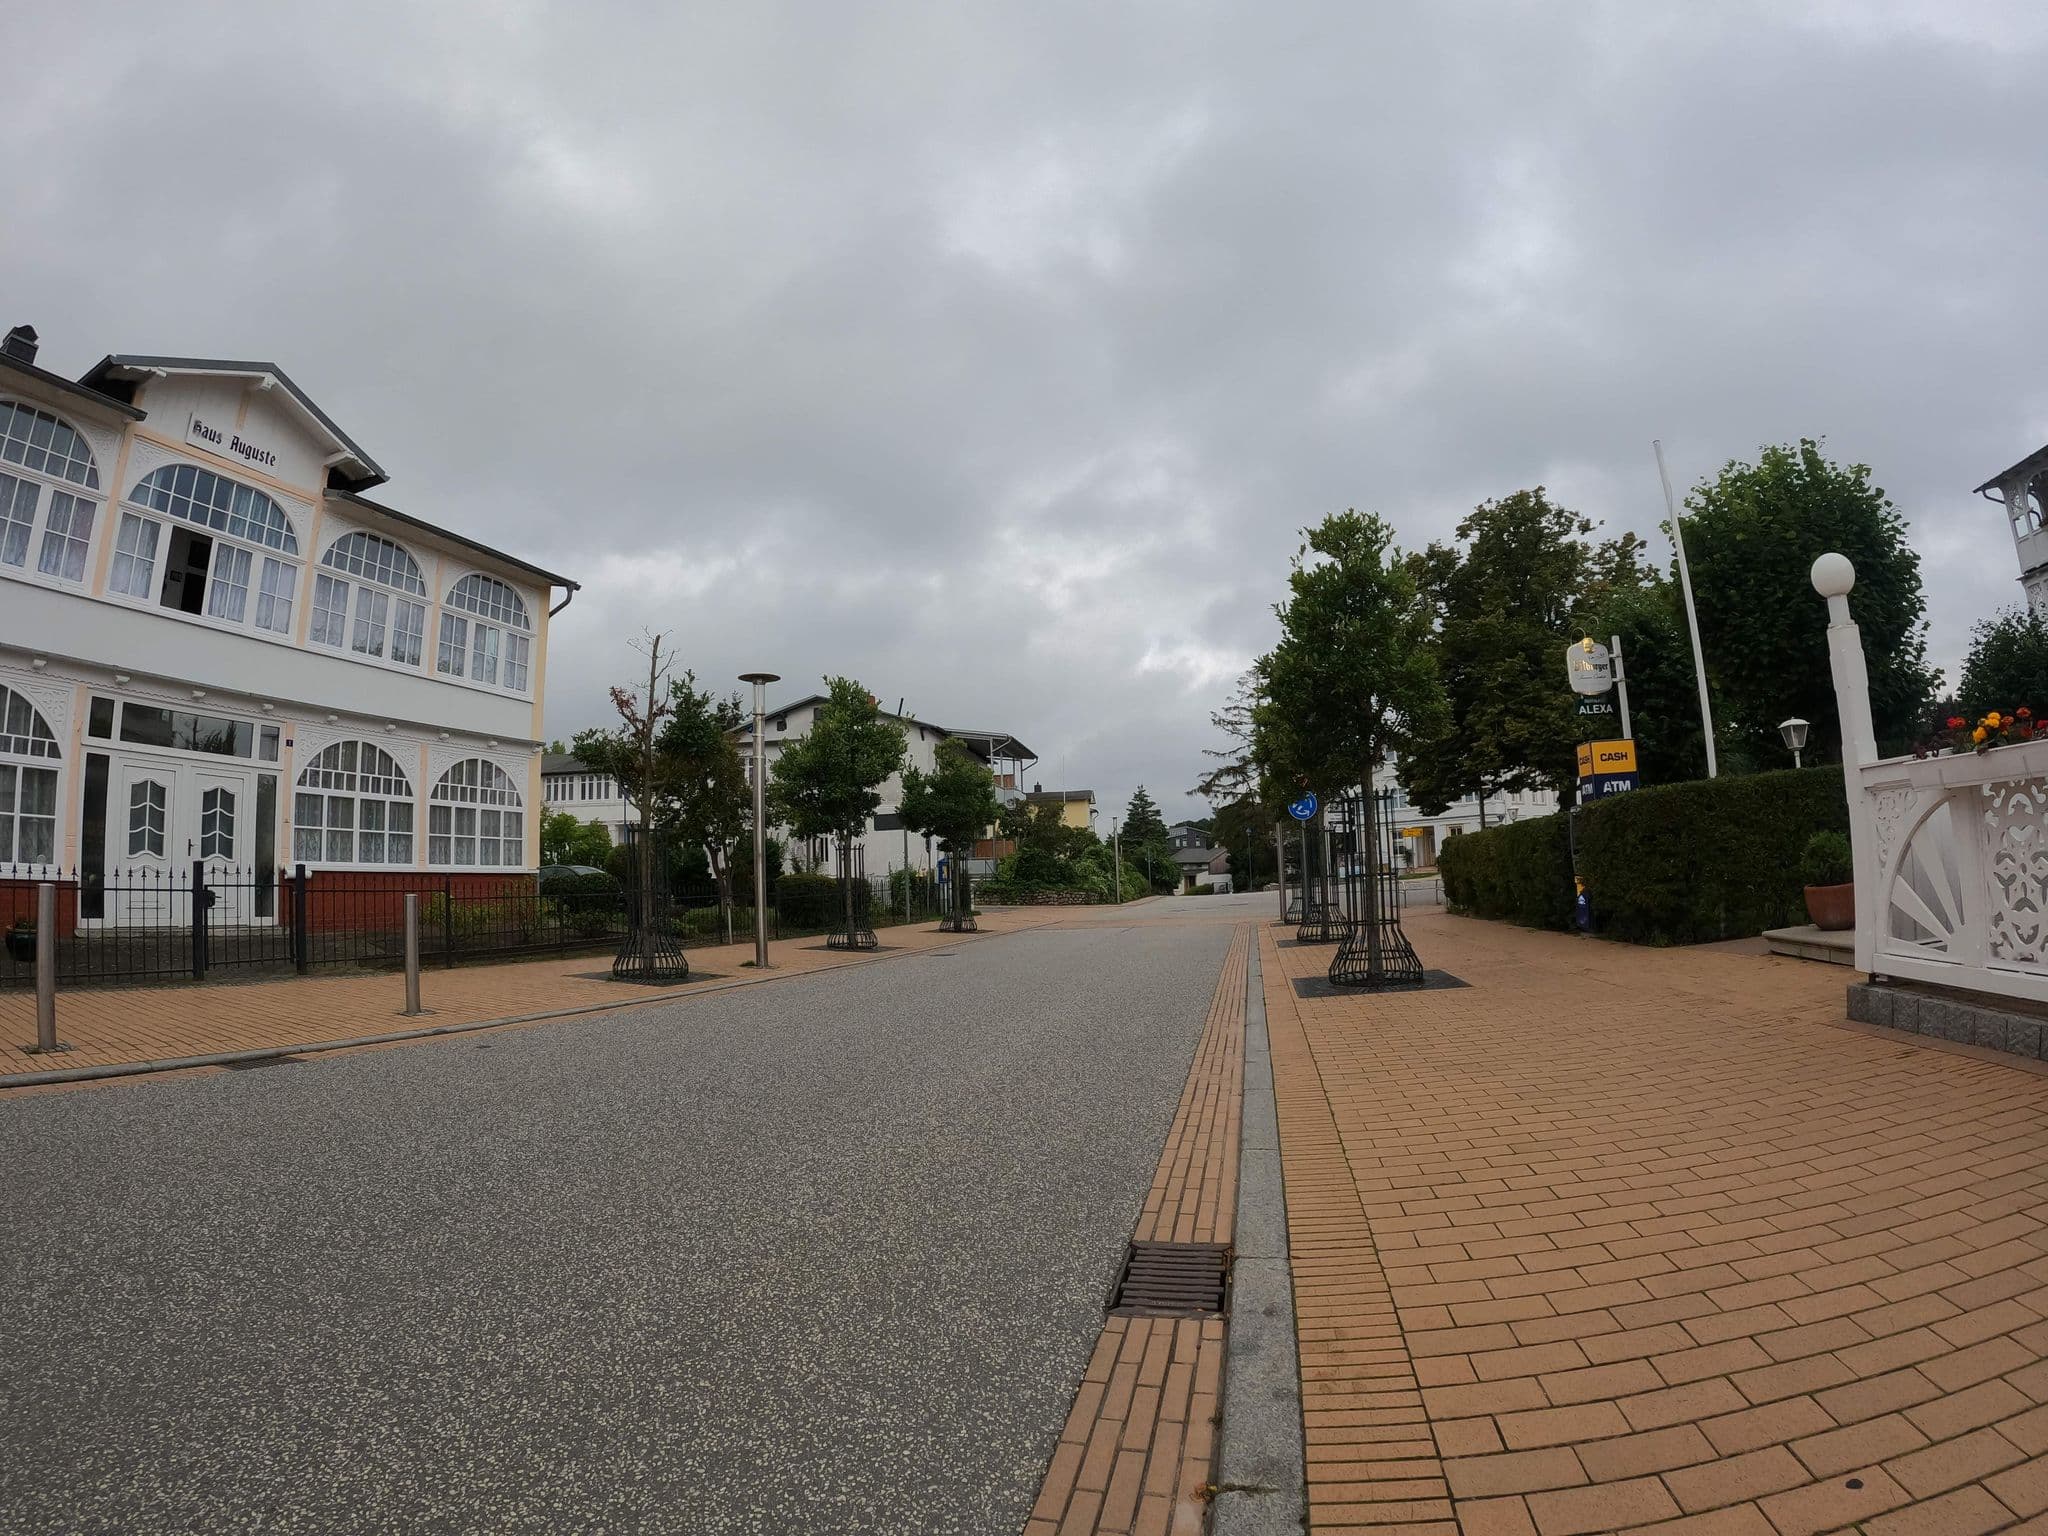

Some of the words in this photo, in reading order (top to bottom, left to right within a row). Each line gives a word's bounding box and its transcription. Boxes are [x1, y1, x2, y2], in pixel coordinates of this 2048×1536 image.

[193, 420, 222, 445] Haus
[230, 435, 276, 466] Auguste
[1579, 704, 1613, 715] ALEXA
[1600, 752, 1628, 761] CASH
[1603, 780, 1631, 793] ATM
